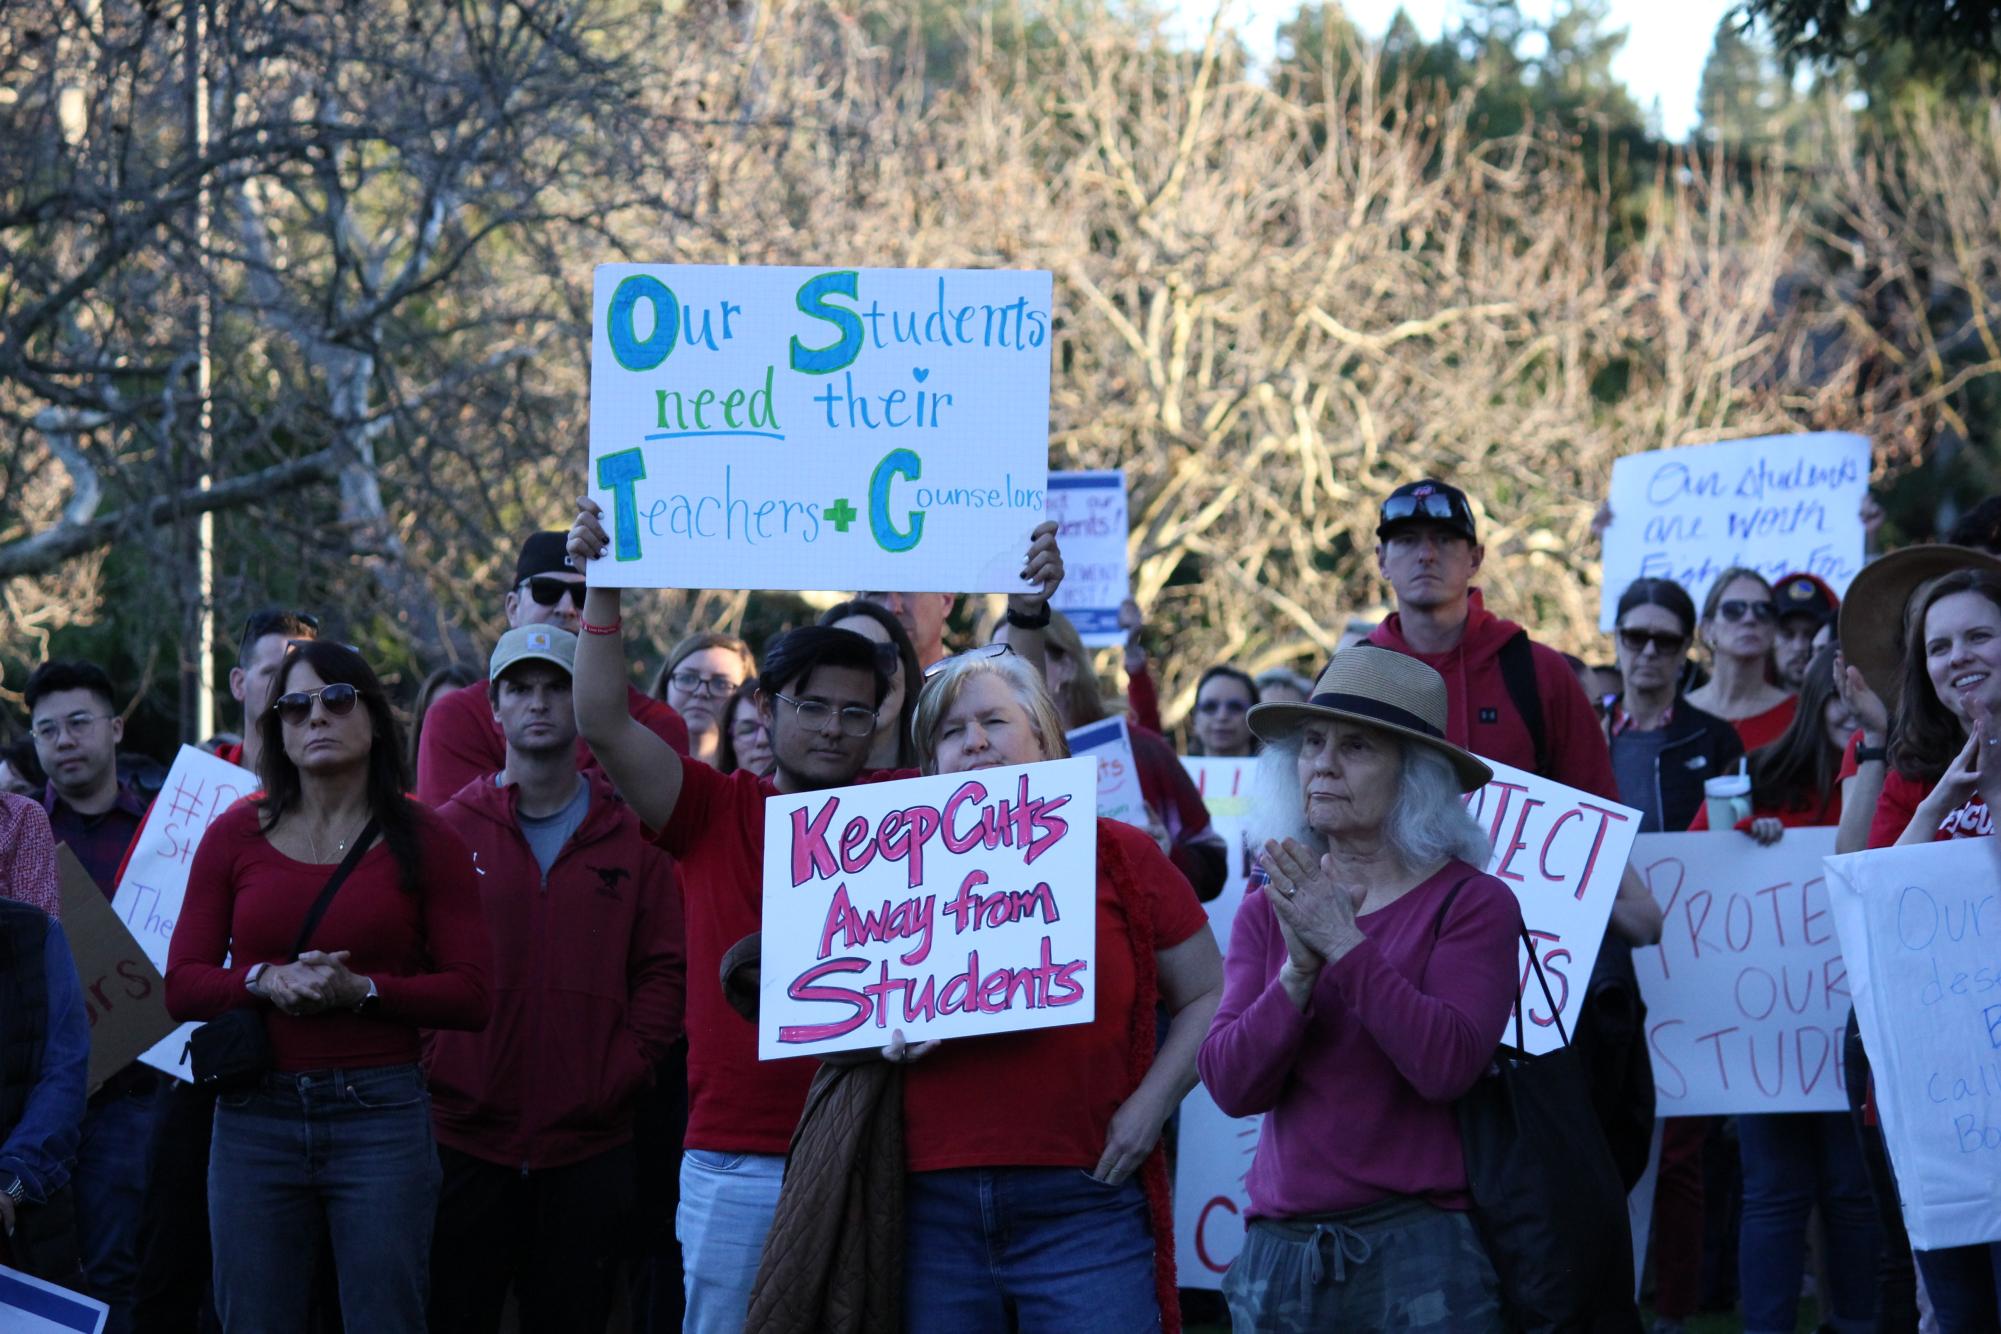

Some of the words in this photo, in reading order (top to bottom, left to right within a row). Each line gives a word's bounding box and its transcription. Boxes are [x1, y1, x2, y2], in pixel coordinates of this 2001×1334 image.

[607, 273, 741, 372] Our
[789, 271, 1046, 375] Students
[655, 365, 782, 430] need
[813, 366, 952, 429] their
[597, 446, 820, 562] Teachers
[867, 447, 1044, 553] Counselors
[1643, 515, 1707, 545] are
[789, 796, 940, 888] Keep
[940, 773, 1072, 866] Cuts
[816, 881, 937, 967] Away
[942, 869, 1061, 936] from
[1898, 886, 1994, 951] Our
[776, 936, 1088, 1044] Students
[1734, 955, 1853, 1021] OUR
